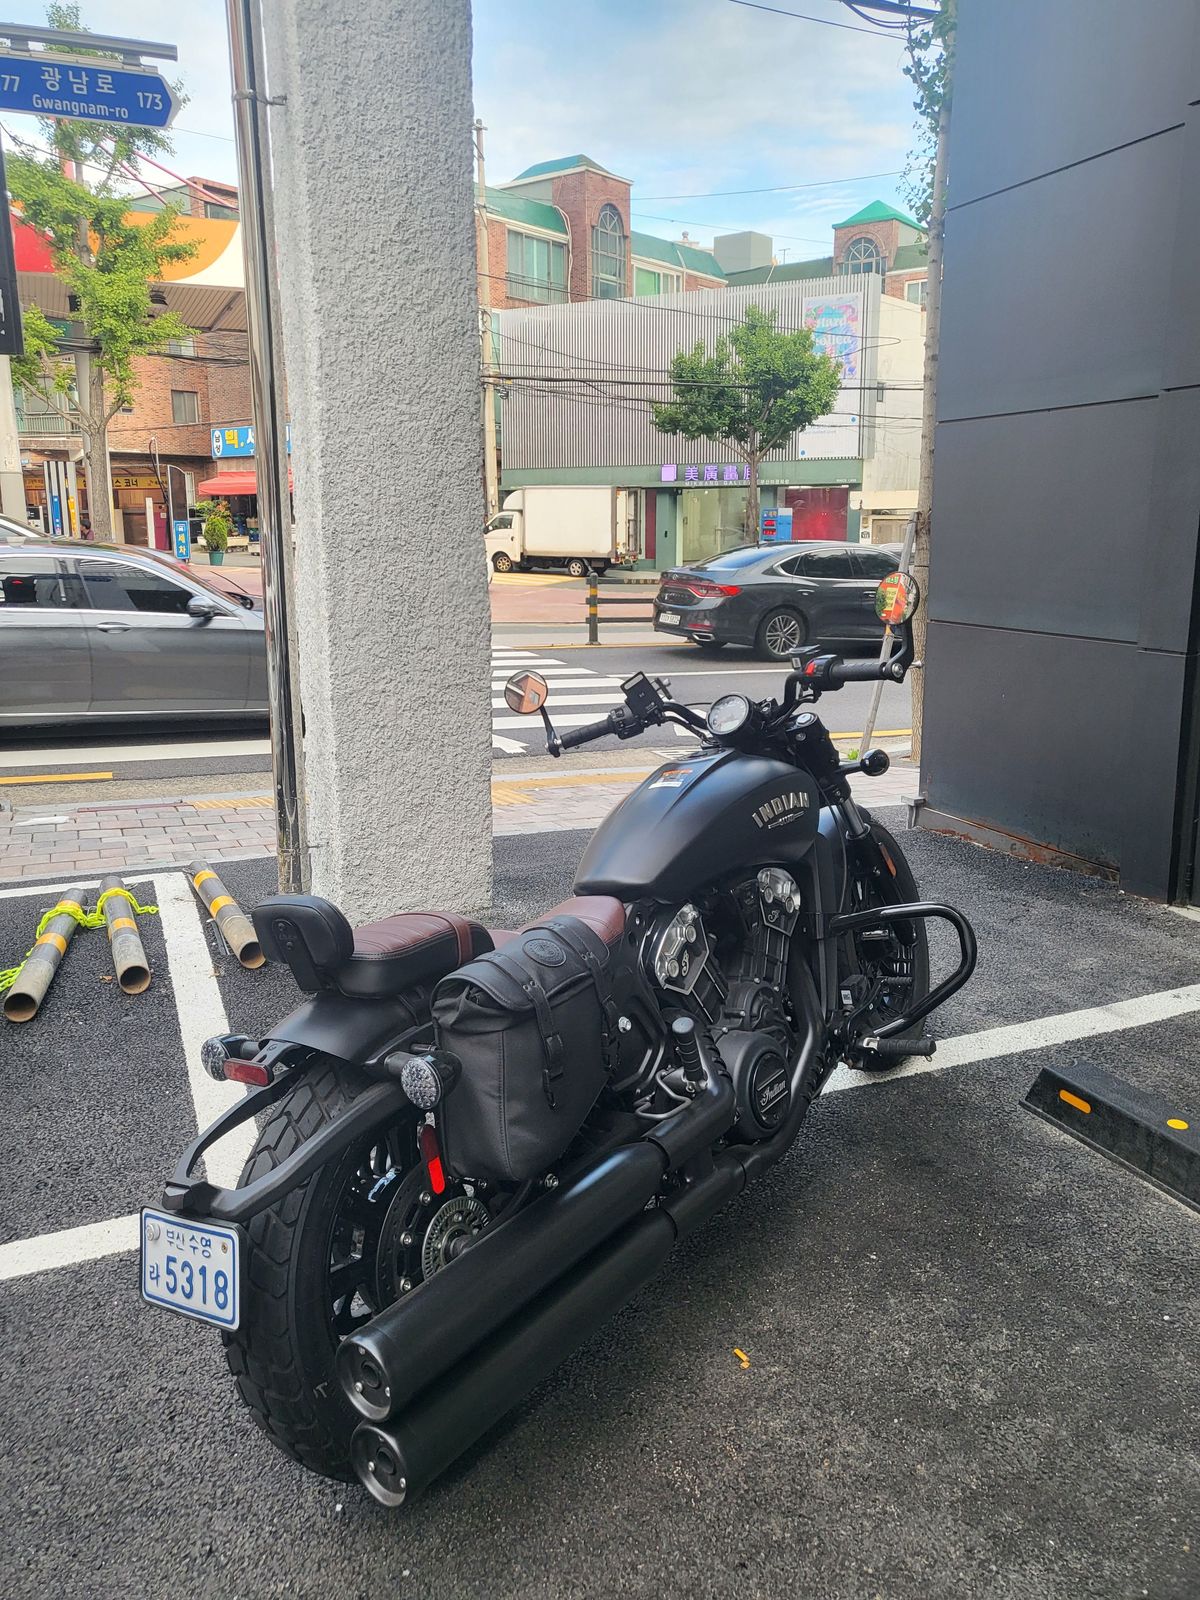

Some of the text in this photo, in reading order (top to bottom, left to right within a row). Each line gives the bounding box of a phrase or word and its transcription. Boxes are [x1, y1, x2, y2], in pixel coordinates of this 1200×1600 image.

[40, 66, 116, 95] 광남로
[137, 92, 163, 110] 173
[32, 94, 129, 119] Gwangnam-ro
[124, 478, 139, 487] 코너
[752, 792, 809, 828] INDIAN
[189, 1234, 211, 1258] 수영
[149, 1255, 228, 1310] 라 5318
